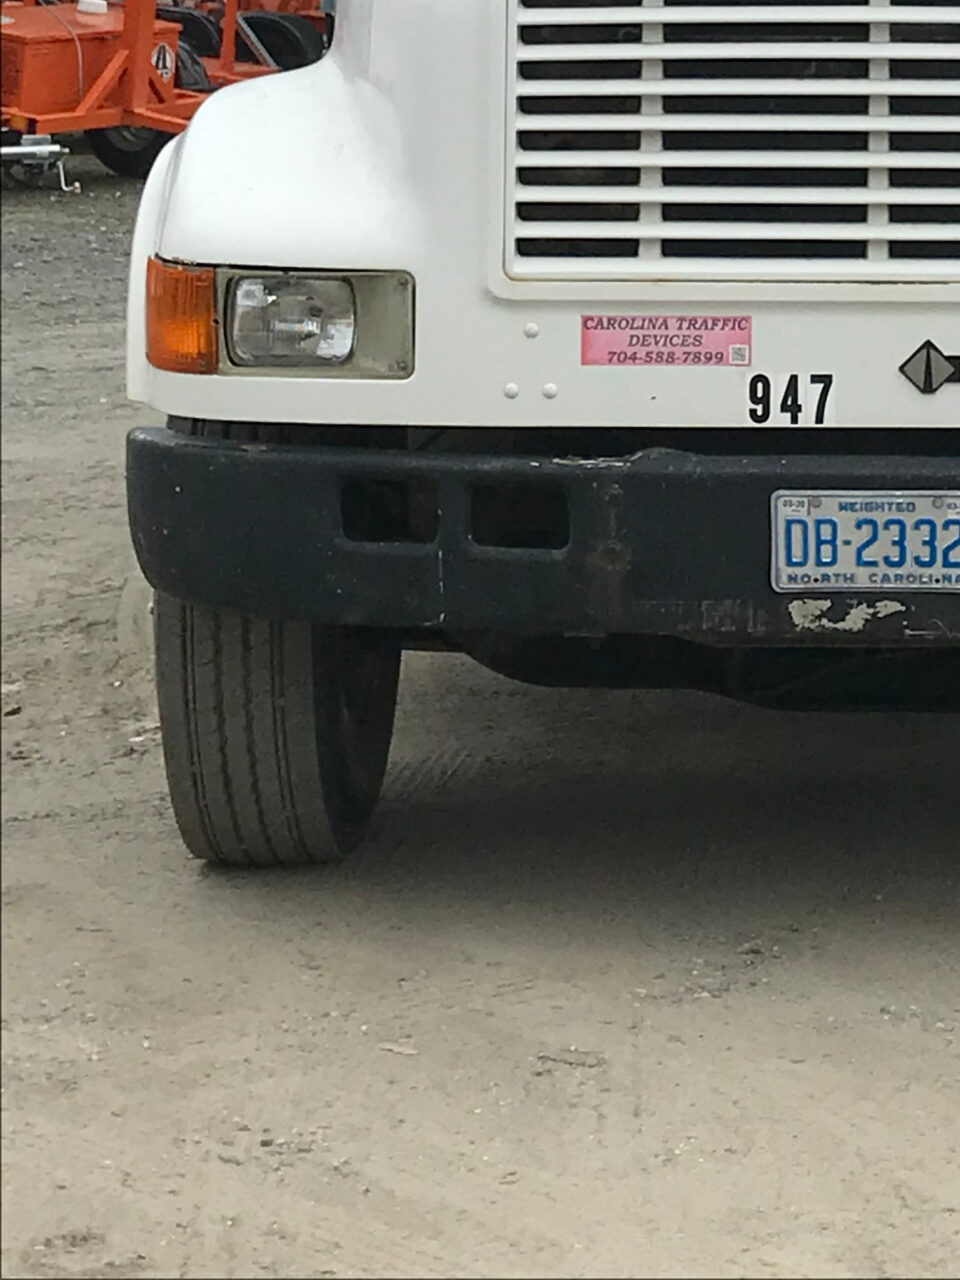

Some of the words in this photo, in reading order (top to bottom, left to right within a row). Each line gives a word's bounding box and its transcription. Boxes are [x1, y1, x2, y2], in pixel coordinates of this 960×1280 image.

[583, 317, 669, 331] CAROLINA
[676, 317, 749, 331] TRAFFIC
[627, 334, 704, 348] DEVICES
[607, 351, 724, 364] 704-588-7899
[748, 374, 834, 424] 947
[838, 501, 916, 513] WEIGHTED
[787, 573, 856, 584] NORTH
